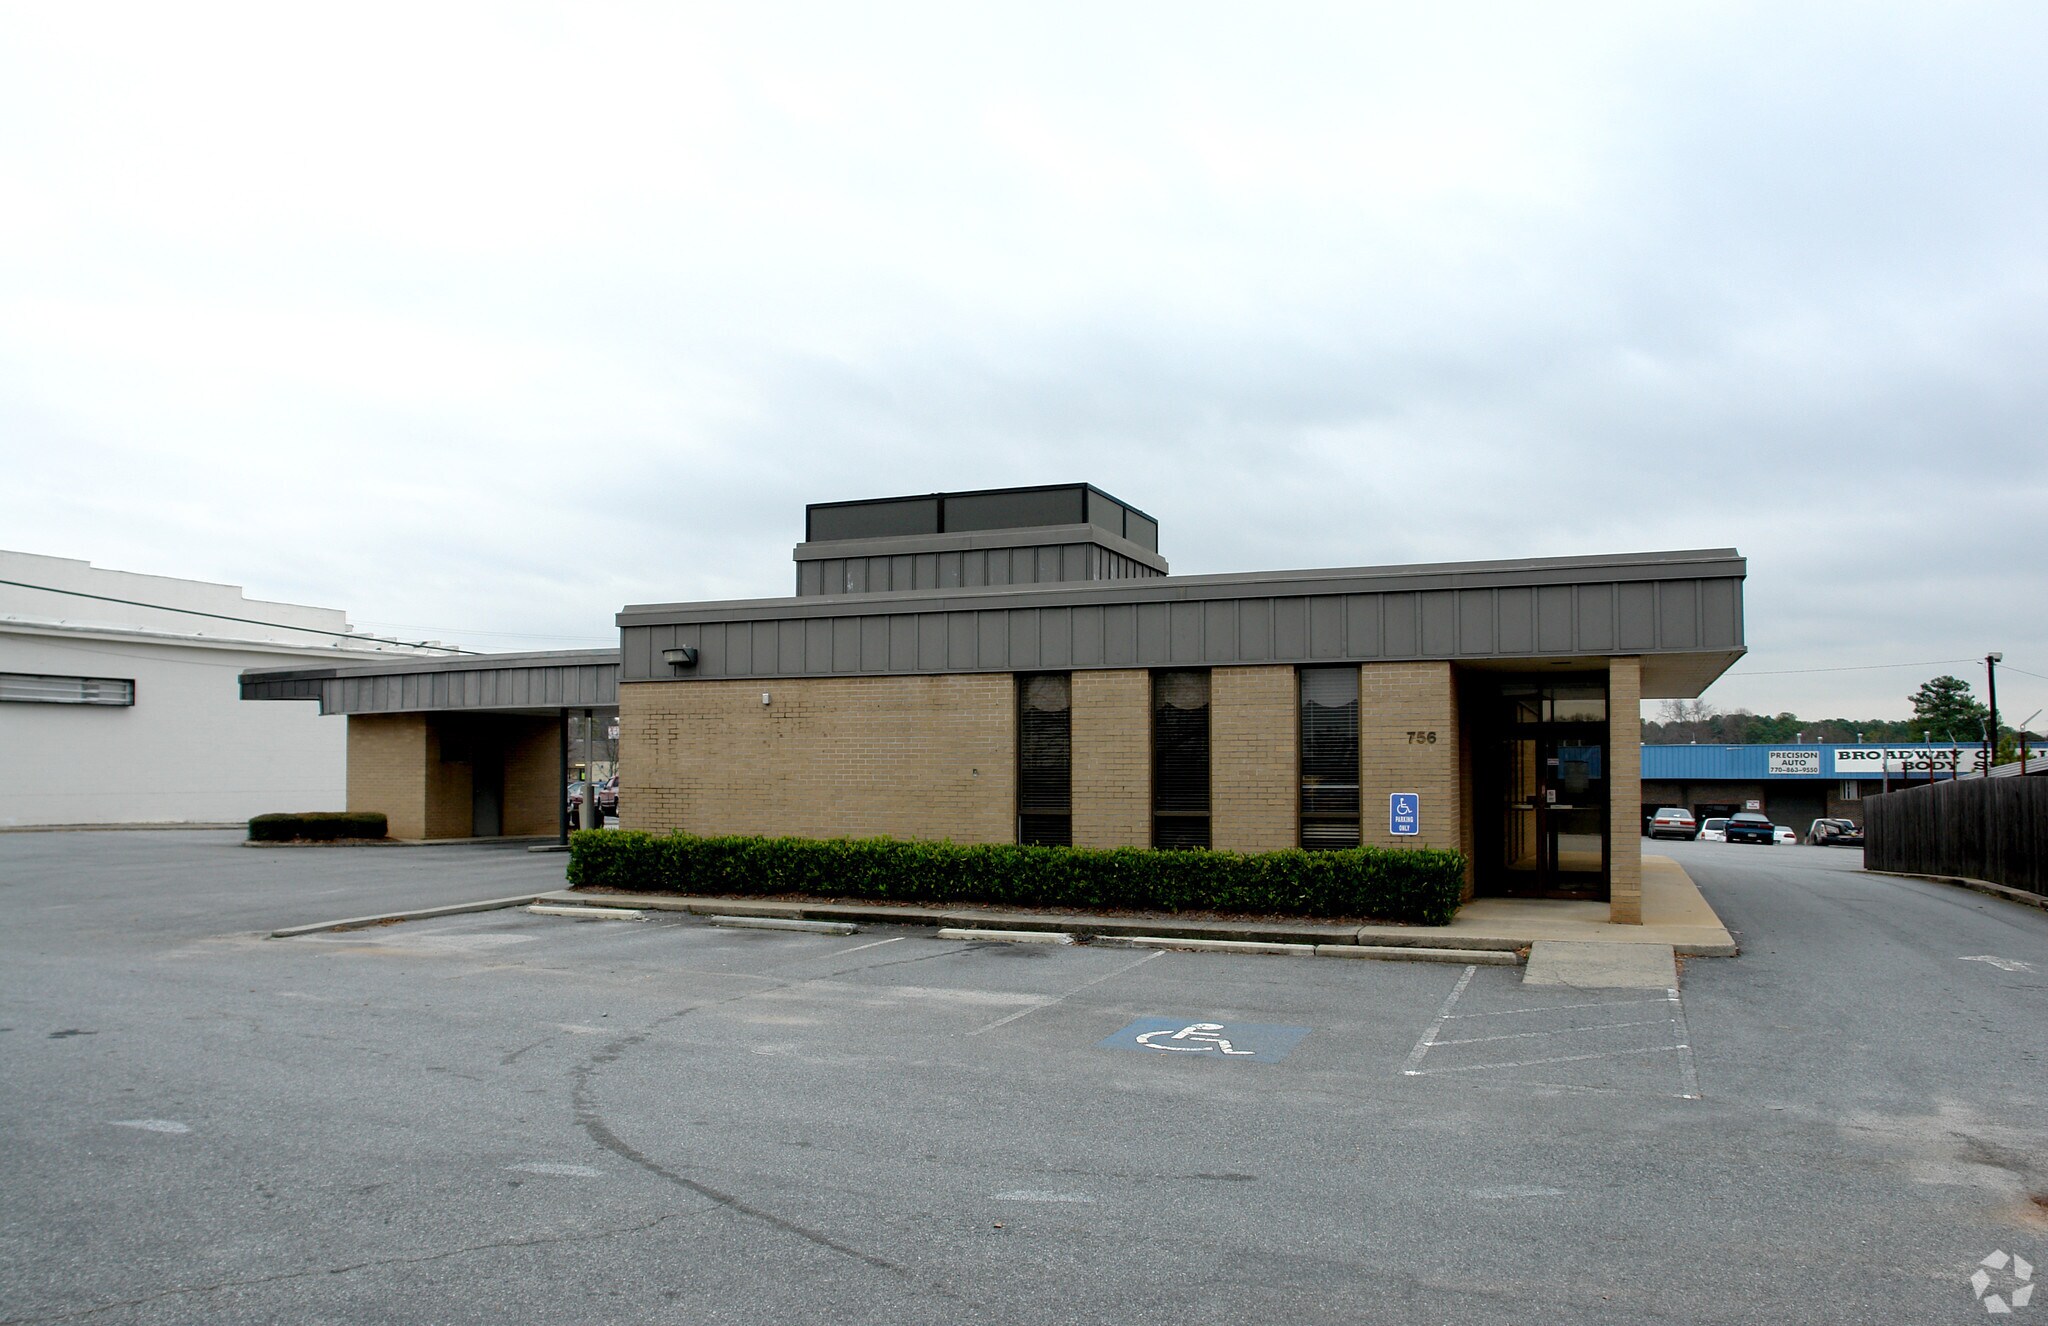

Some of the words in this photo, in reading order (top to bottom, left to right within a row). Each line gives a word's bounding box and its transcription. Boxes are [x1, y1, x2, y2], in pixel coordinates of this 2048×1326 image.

[1406, 731, 1437, 745] 756
[1838, 750, 1964, 760] BROADWAY
[1901, 761, 1960, 770] BODY
